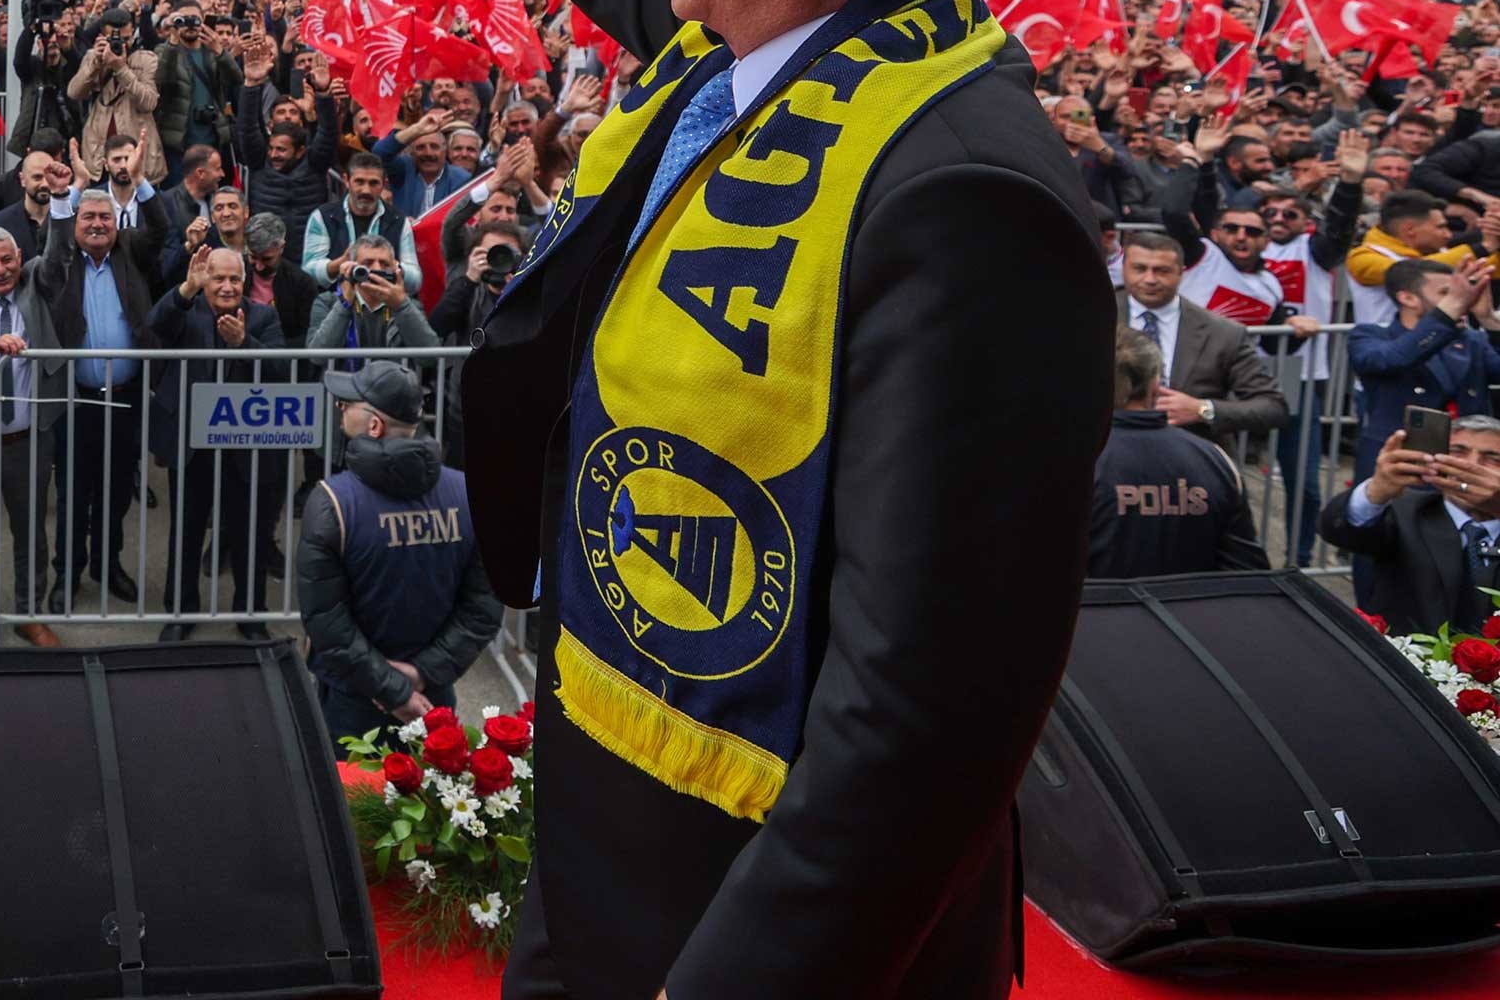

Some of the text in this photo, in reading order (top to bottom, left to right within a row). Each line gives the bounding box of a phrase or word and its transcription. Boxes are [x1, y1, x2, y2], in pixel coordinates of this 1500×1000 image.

[208, 388, 315, 427] AĞRI
[207, 430, 314, 446] EMNİYET MÜDÜRLÜĞÜ
[590, 438, 675, 493] SPOR
[1114, 477, 1209, 516] POLİS
[378, 507, 463, 547] TEM
[750, 550, 786, 632] 1970
